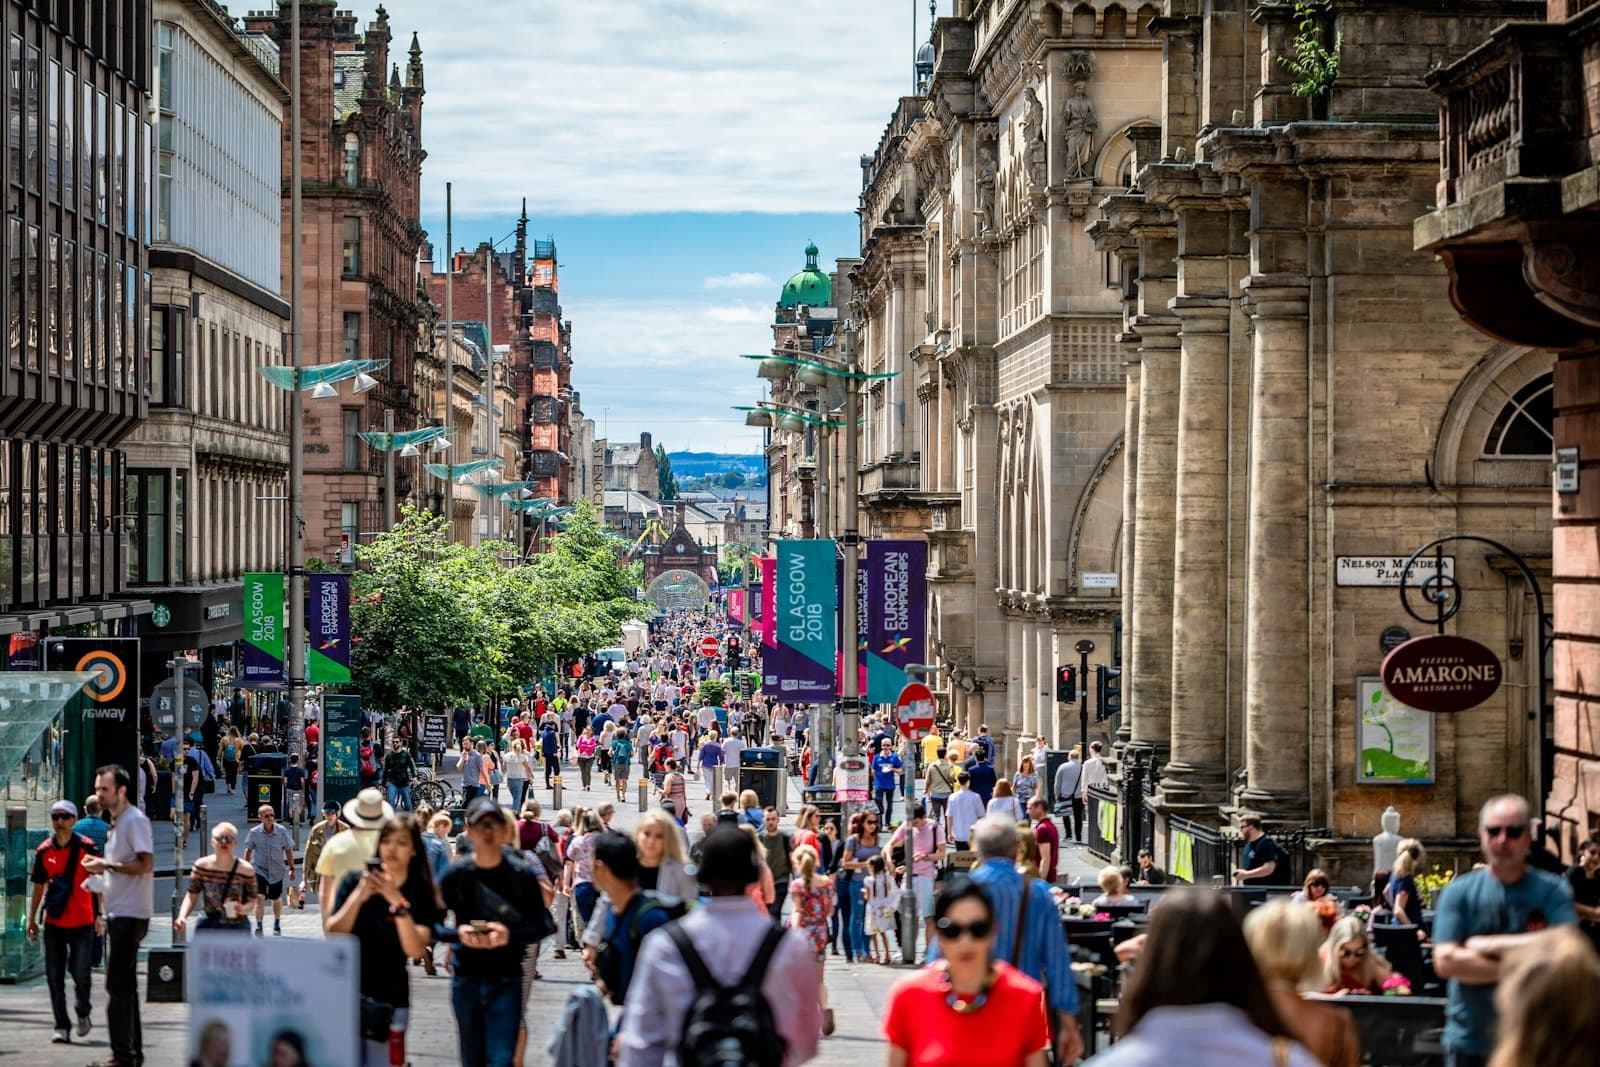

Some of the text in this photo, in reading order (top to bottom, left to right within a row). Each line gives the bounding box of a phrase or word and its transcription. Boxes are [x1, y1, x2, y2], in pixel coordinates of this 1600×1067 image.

[593, 447, 604, 461] ST
[1342, 559, 1386, 569] NELSON
[321, 581, 331, 634] EUROPEAN
[789, 552, 806, 642] GLASGOW
[884, 551, 898, 631] EUROPEAN
[898, 552, 909, 631] CHAMPIONSHIPS
[252, 581, 264, 641] GLASGOW
[264, 615, 275, 641] 2018
[807, 603, 823, 641] 2018
[1391, 665, 1496, 685] AMARONE
[1412, 684, 1473, 693] RISTORANTE
